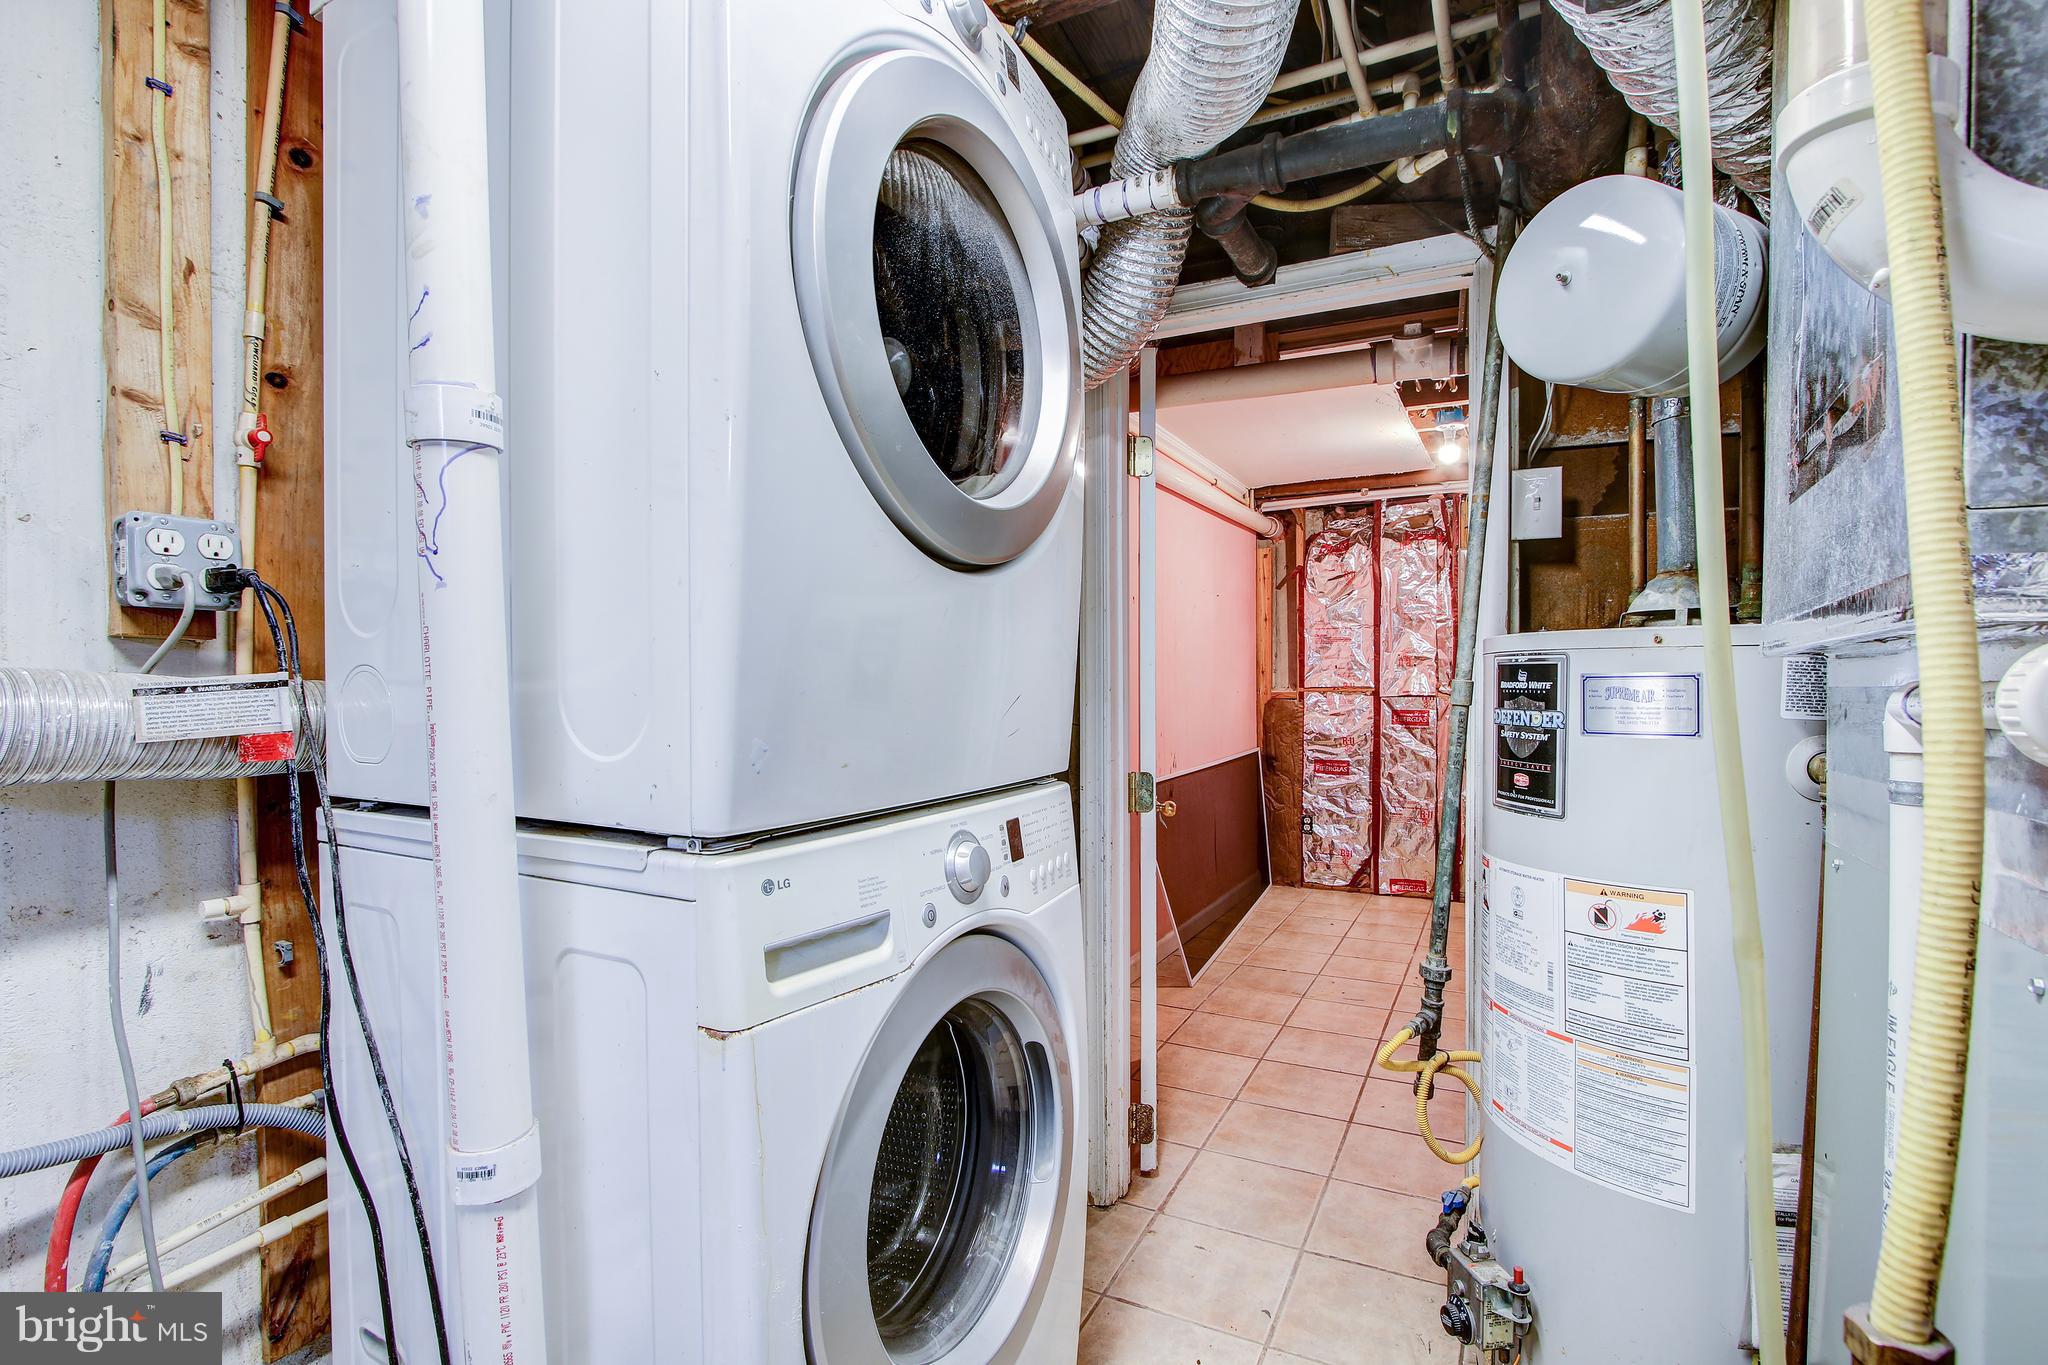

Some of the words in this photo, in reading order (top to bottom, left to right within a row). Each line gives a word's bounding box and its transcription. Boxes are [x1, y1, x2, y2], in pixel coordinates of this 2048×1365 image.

[263, 205, 272, 264] CHARLOTT
[422, 626, 432, 680] CHARLOTTE
[197, 684, 230, 692] WARNING
[1500, 681, 1528, 689] BRADFORD
[1494, 708, 1565, 729] DEFENDER
[1500, 730, 1520, 739] SAFETY
[1520, 731, 1550, 741] SYSTEM
[1315, 765, 1347, 773] FIBERGLAS
[777, 878, 791, 890] LG
[1391, 883, 1425, 892] FIBERGLAS
[1610, 890, 1645, 900] WARNING
[1888, 1009, 1898, 1034] JM
[1886, 1037, 1896, 1093] EAGLE
[497, 1270, 507, 1280] PSI
[499, 1295, 509, 1303] PR
[500, 1305, 510, 1319] 1120
[501, 1322, 511, 1333] PVC
